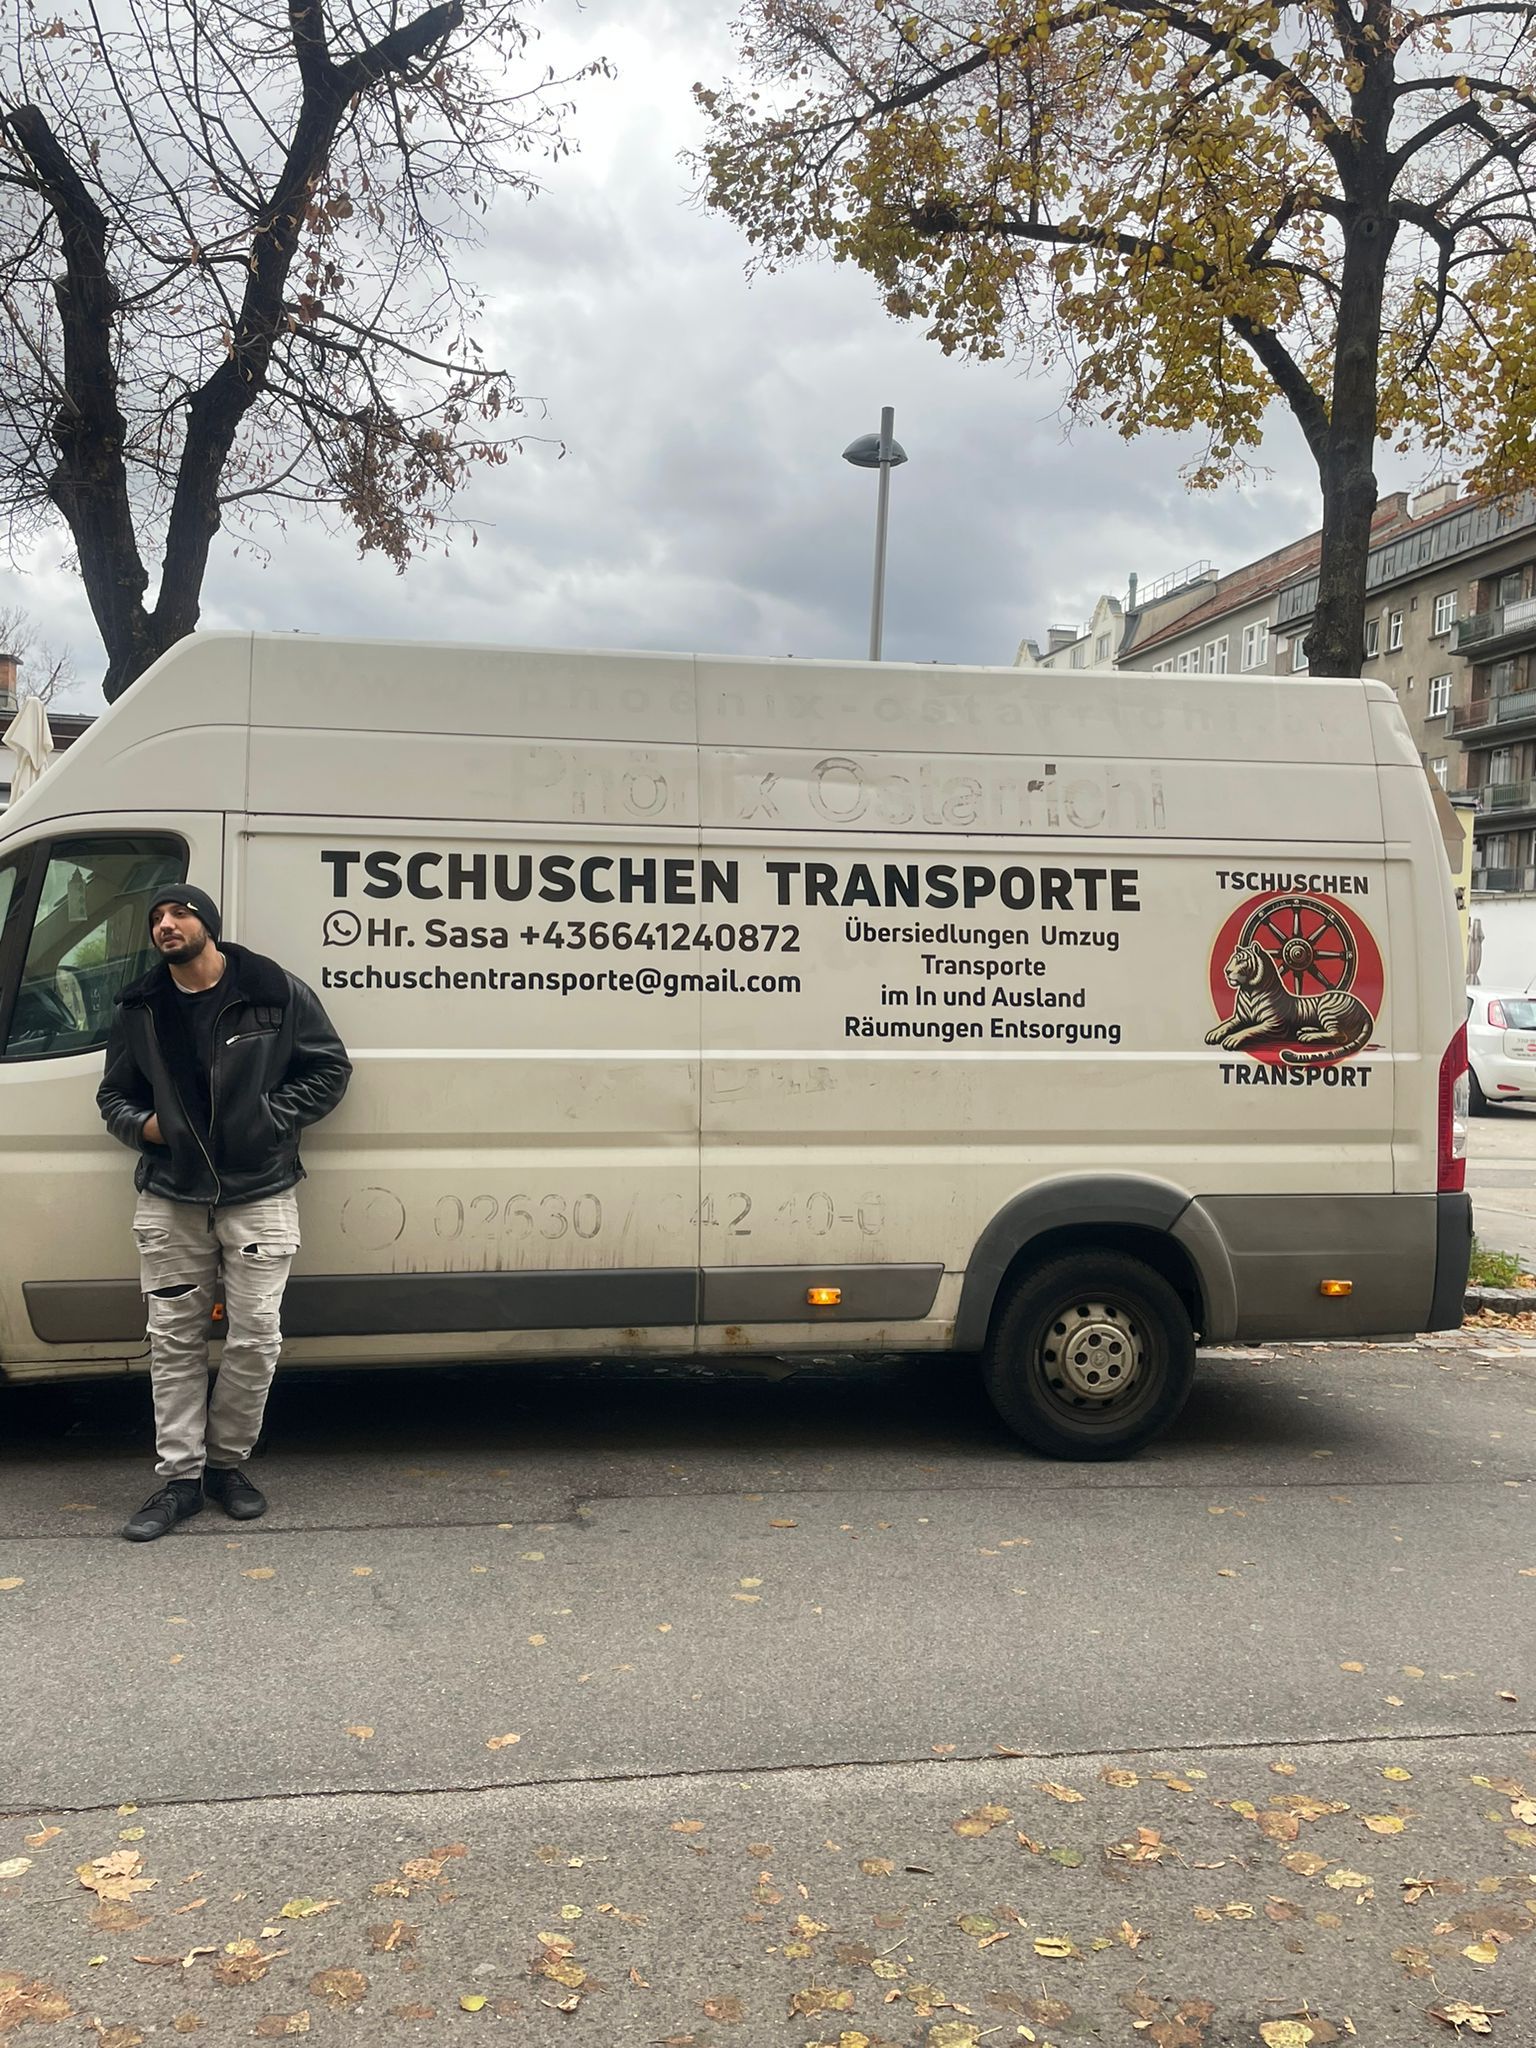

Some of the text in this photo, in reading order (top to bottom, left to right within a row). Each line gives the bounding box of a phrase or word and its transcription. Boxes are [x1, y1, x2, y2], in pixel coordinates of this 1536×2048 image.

[320, 850, 1142, 912] TSCHUSCHEN TRANSPORTE
[1215, 870, 1369, 895] TSCHUSCHEN
[366, 917, 801, 954] Hr. Sasa +436641240872
[844, 916, 1120, 952] Übersiedlungen Umzug
[320, 964, 801, 998] tschuschentransporte@gmail.com
[920, 954, 1047, 981] Transporte
[880, 984, 1087, 1009] im In und Ausland
[844, 1016, 1122, 1045] Räumungen Entsorgung
[1219, 1063, 1372, 1087] TRANSPORT
